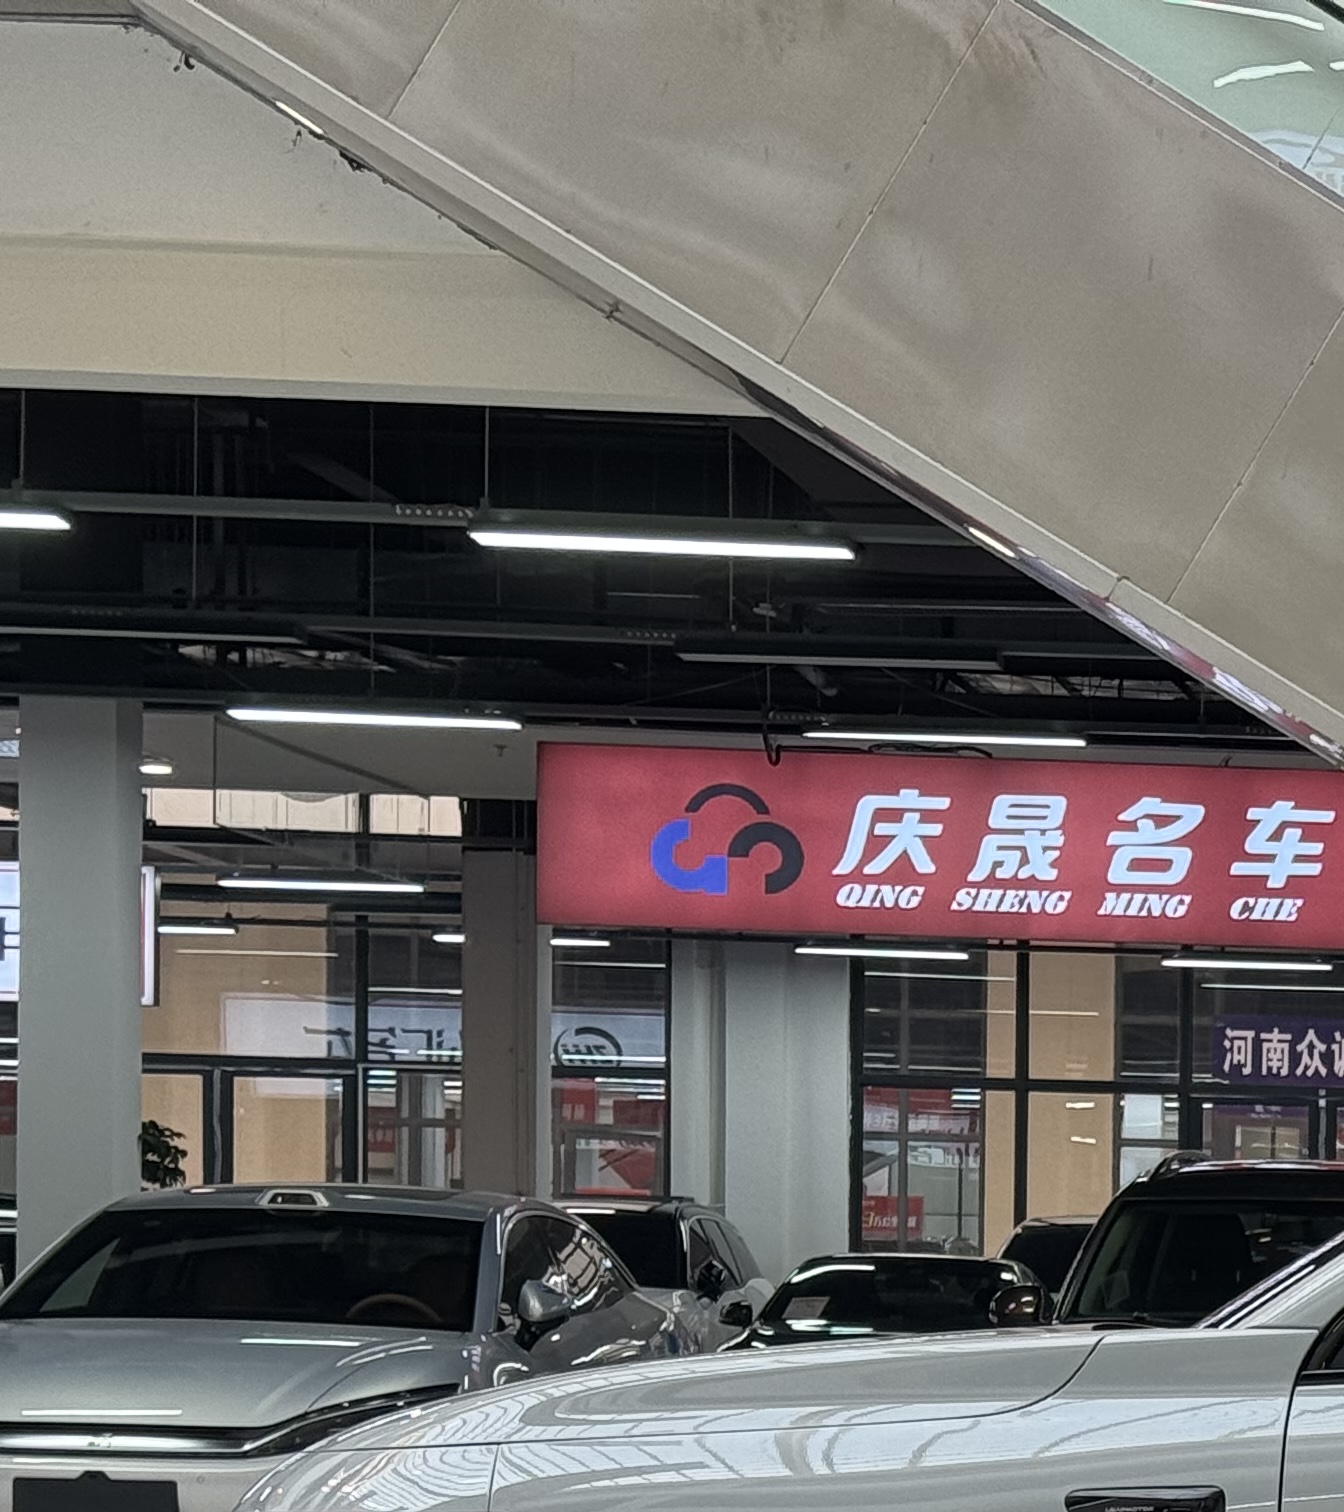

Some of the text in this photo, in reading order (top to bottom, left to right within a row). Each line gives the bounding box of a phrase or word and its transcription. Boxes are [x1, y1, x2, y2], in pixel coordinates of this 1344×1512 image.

[833, 788, 1336, 889] 庆晟名车
[835, 883, 1304, 922] QING SHENG MING CHE
